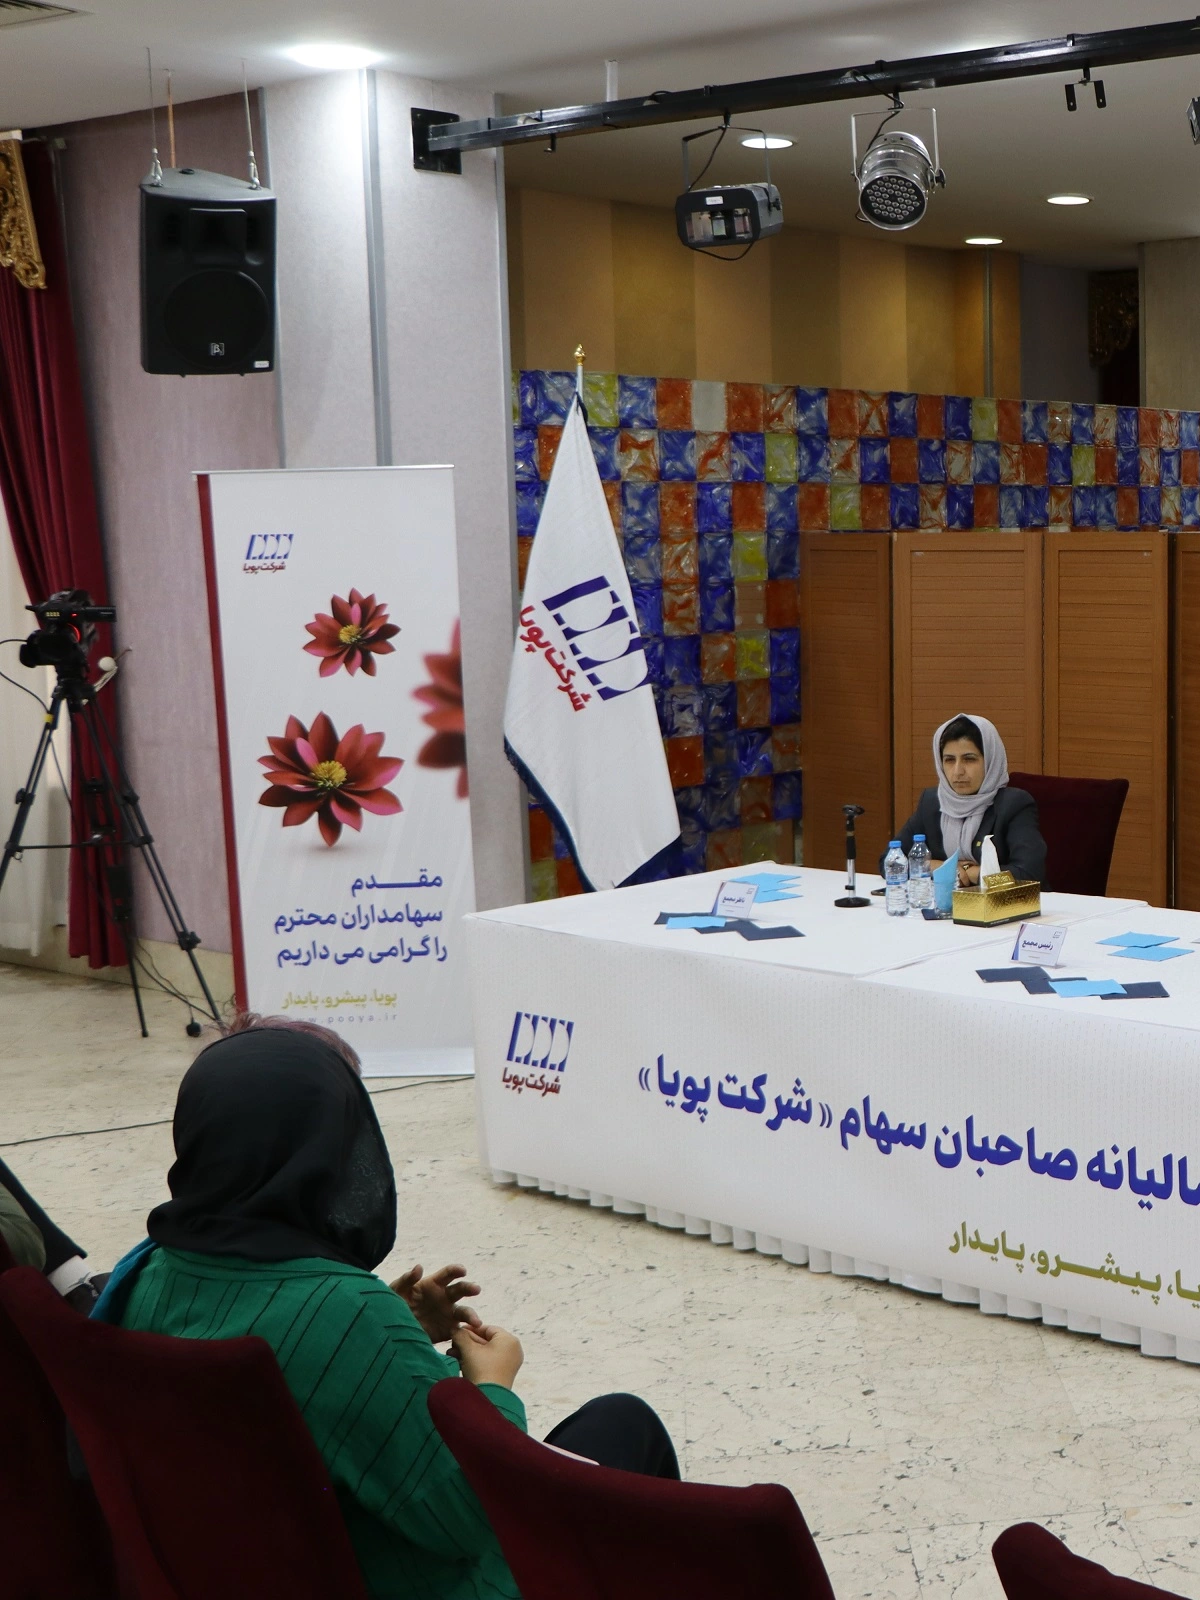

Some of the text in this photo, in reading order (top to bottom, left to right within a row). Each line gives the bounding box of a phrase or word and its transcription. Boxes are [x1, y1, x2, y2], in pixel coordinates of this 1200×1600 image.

[243, 561, 286, 574] شرکت پویا
[519, 605, 592, 712] شرکت پویا
[351, 868, 443, 897] مقدم
[274, 903, 443, 934] سهامداران محترم
[277, 934, 448, 968] را گرامی می داریم
[281, 991, 319, 1010] پایدار
[502, 1067, 561, 1097] شرکت پویا
[839, 1096, 927, 1155] سهام
[934, 1115, 1079, 1182] صاحبان
[949, 1221, 1025, 1274] پایدار
